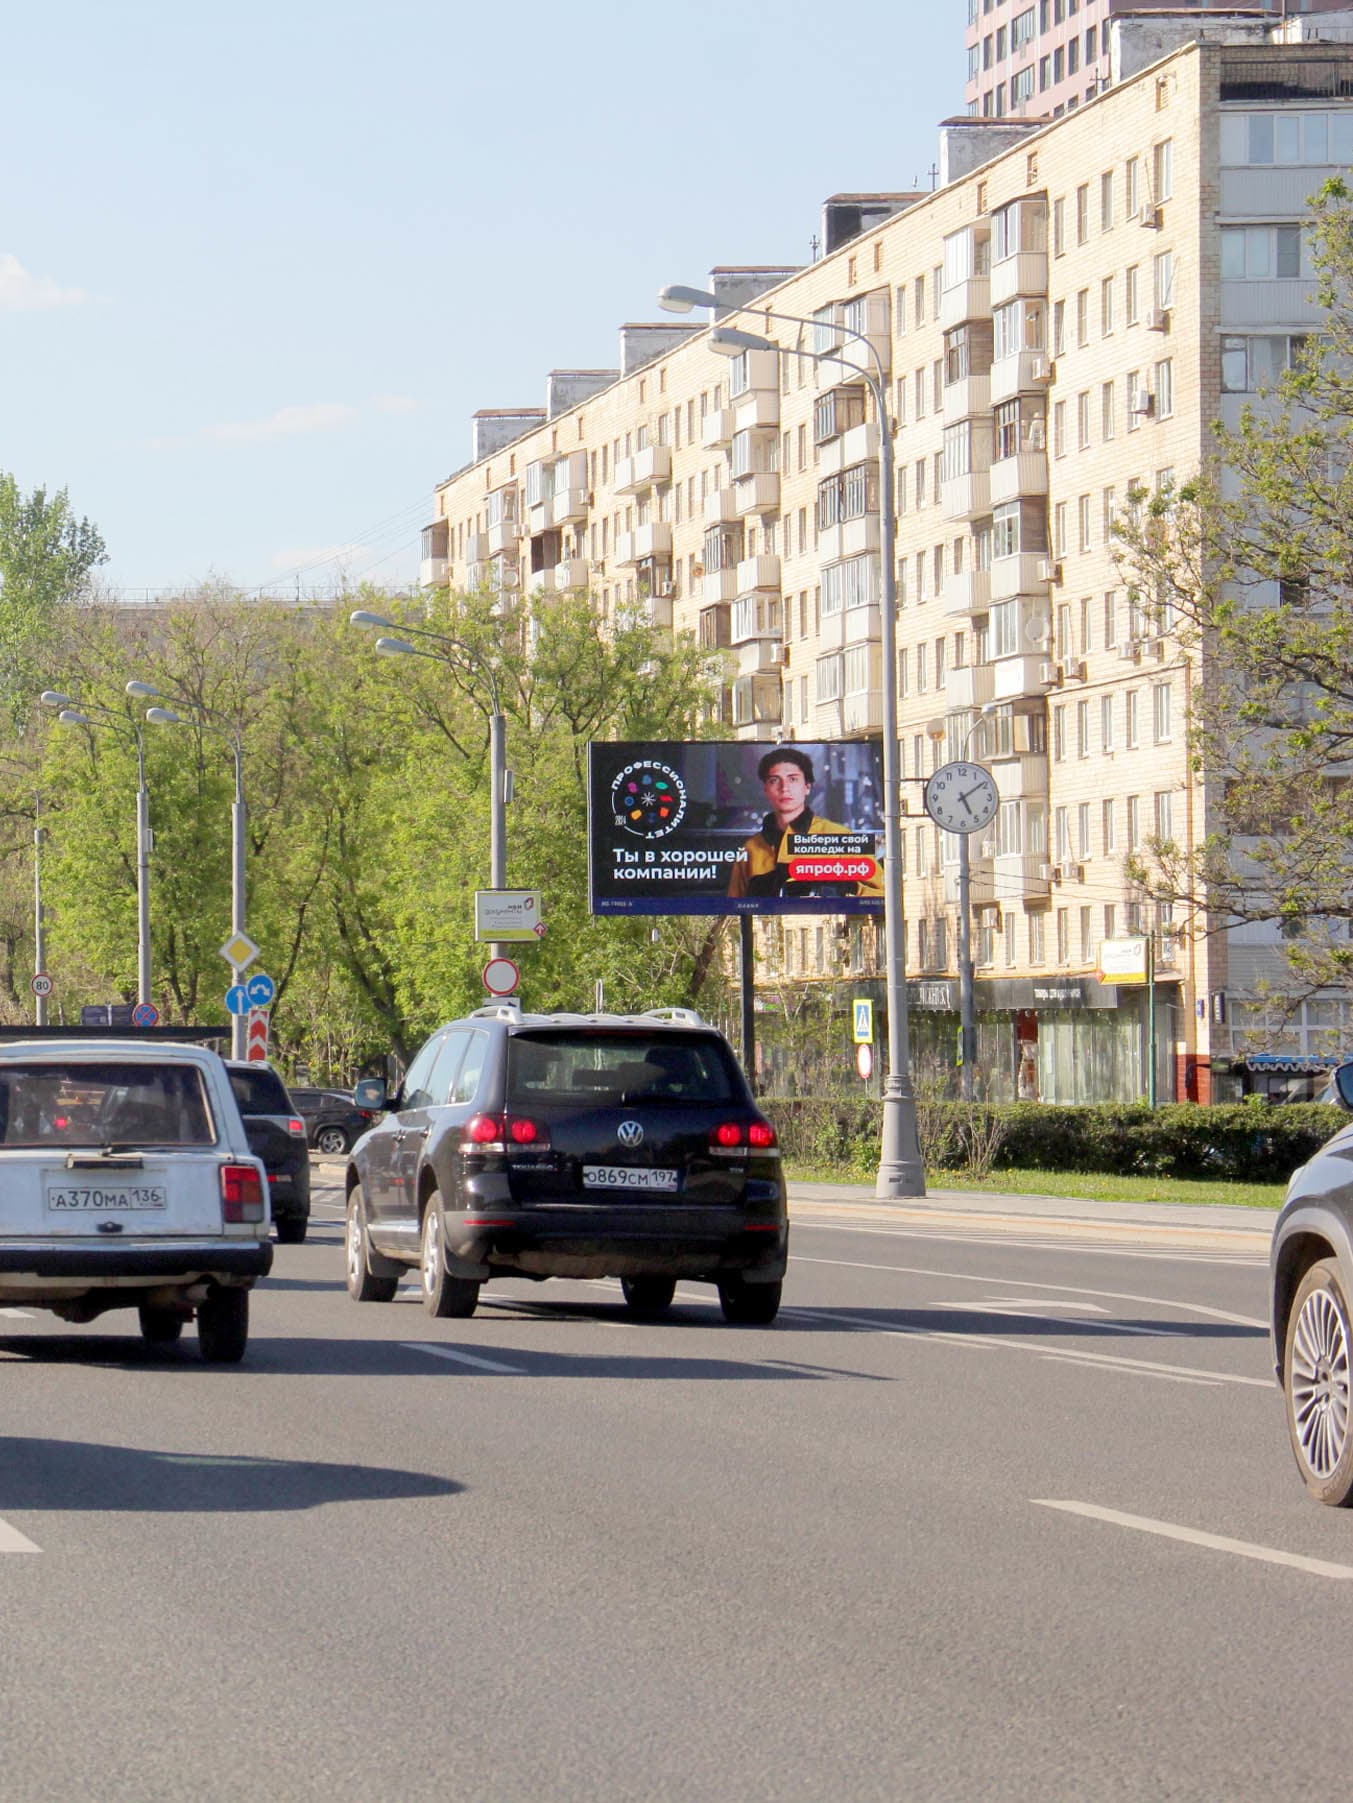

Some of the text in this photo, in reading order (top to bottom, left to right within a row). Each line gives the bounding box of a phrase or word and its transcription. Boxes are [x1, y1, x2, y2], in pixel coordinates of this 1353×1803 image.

[946, 772, 952, 780] 11
[958, 768, 967, 776] 12
[936, 782, 945, 790] 10
[611, 760, 687, 839] ПРОФЕССИОНАЛИТЕТ
[794, 834, 869, 846] Выбери свой
[794, 845, 846, 854] колледж
[613, 847, 748, 865] Ты в хорошей
[614, 865, 717, 880] компании!
[795, 861, 870, 875] япроф.рф
[36, 981, 49, 990] 80
[651, 1170, 673, 1182] 197
[133, 1190, 161, 1202] 136
